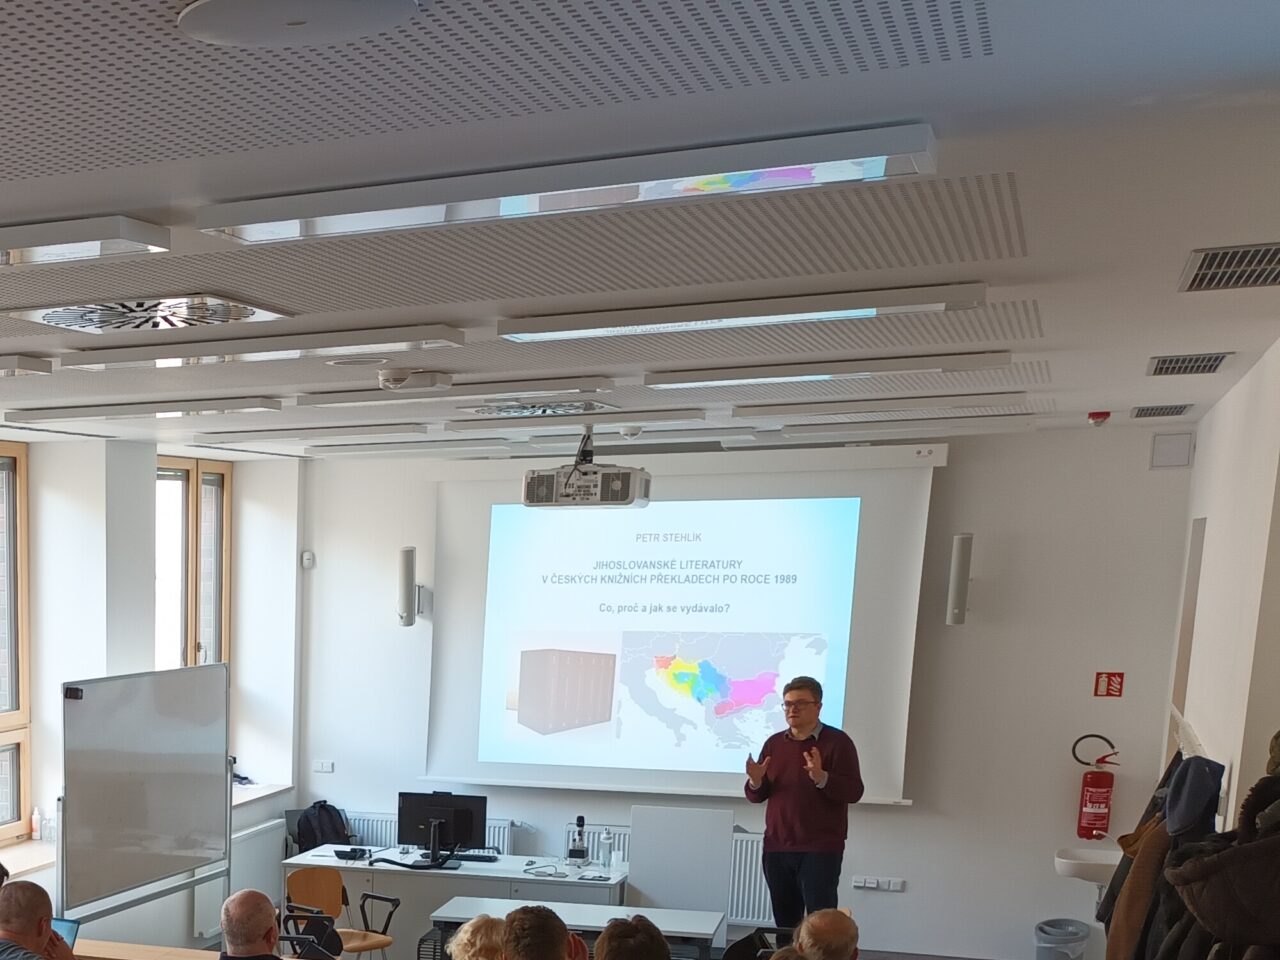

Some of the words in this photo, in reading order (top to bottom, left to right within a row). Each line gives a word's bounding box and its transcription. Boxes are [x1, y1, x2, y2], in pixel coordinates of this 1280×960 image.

[635, 533, 660, 543] PETR
[662, 531, 703, 543] STEHLÍK
[592, 558, 677, 570] JIHOSLOVANSKÉ
[679, 560, 743, 570] LITERATURY
[541, 575, 549, 584] V
[550, 573, 598, 585] ČESKÝCH
[600, 573, 647, 585] KNIŽNÍCH
[650, 573, 720, 585] PŘEKLADECH
[722, 574, 738, 585] PO
[740, 574, 771, 584] ROCE
[773, 574, 798, 584] 1989
[599, 603, 615, 614] Co,
[617, 602, 639, 616] proč
[641, 605, 647, 613] a
[649, 603, 664, 615] jak
[666, 605, 678, 613] se
[680, 602, 731, 616] vydávalo?
